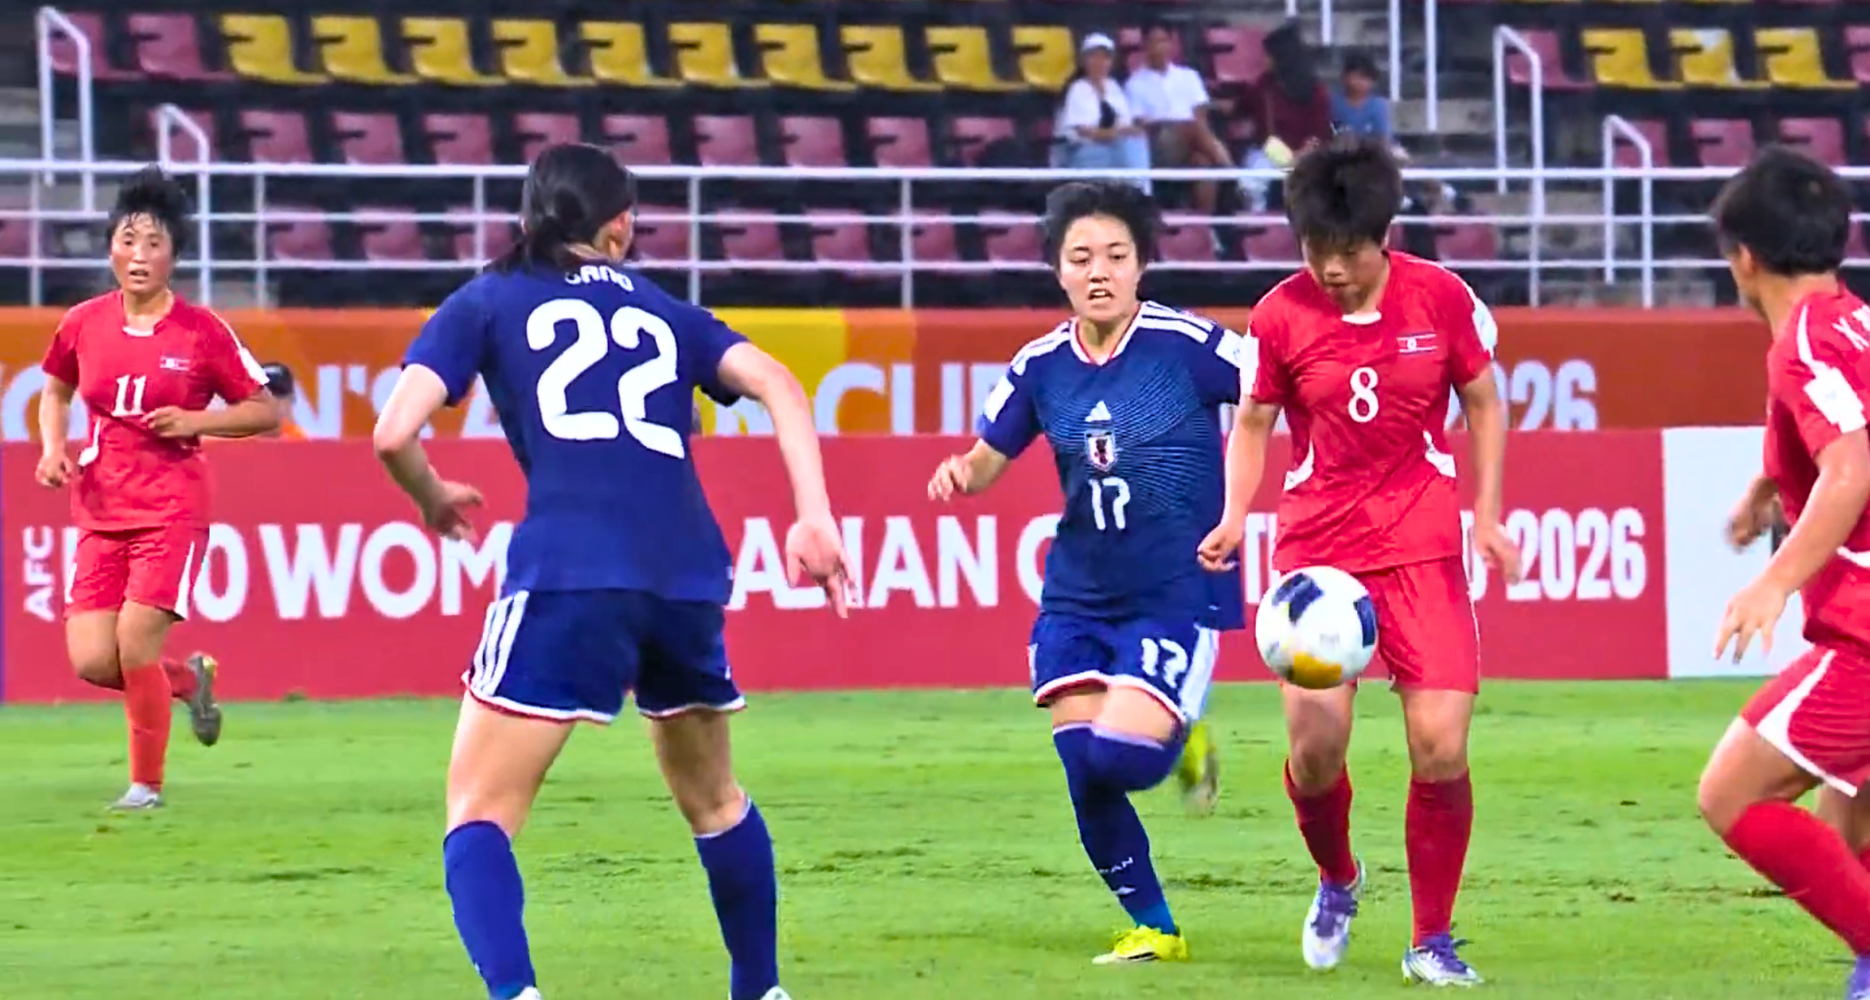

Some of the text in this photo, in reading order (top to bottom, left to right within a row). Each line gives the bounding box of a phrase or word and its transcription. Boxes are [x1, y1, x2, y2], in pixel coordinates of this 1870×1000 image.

[112, 374, 147, 417] 11
[526, 298, 685, 459] 22
[1348, 367, 1379, 423] 8
[1443, 360, 1597, 431] 26
[1088, 477, 1131, 530] 17
[22, 525, 55, 621] AFC
[725, 515, 999, 611] AIAN
[1505, 507, 1647, 600] 2026
